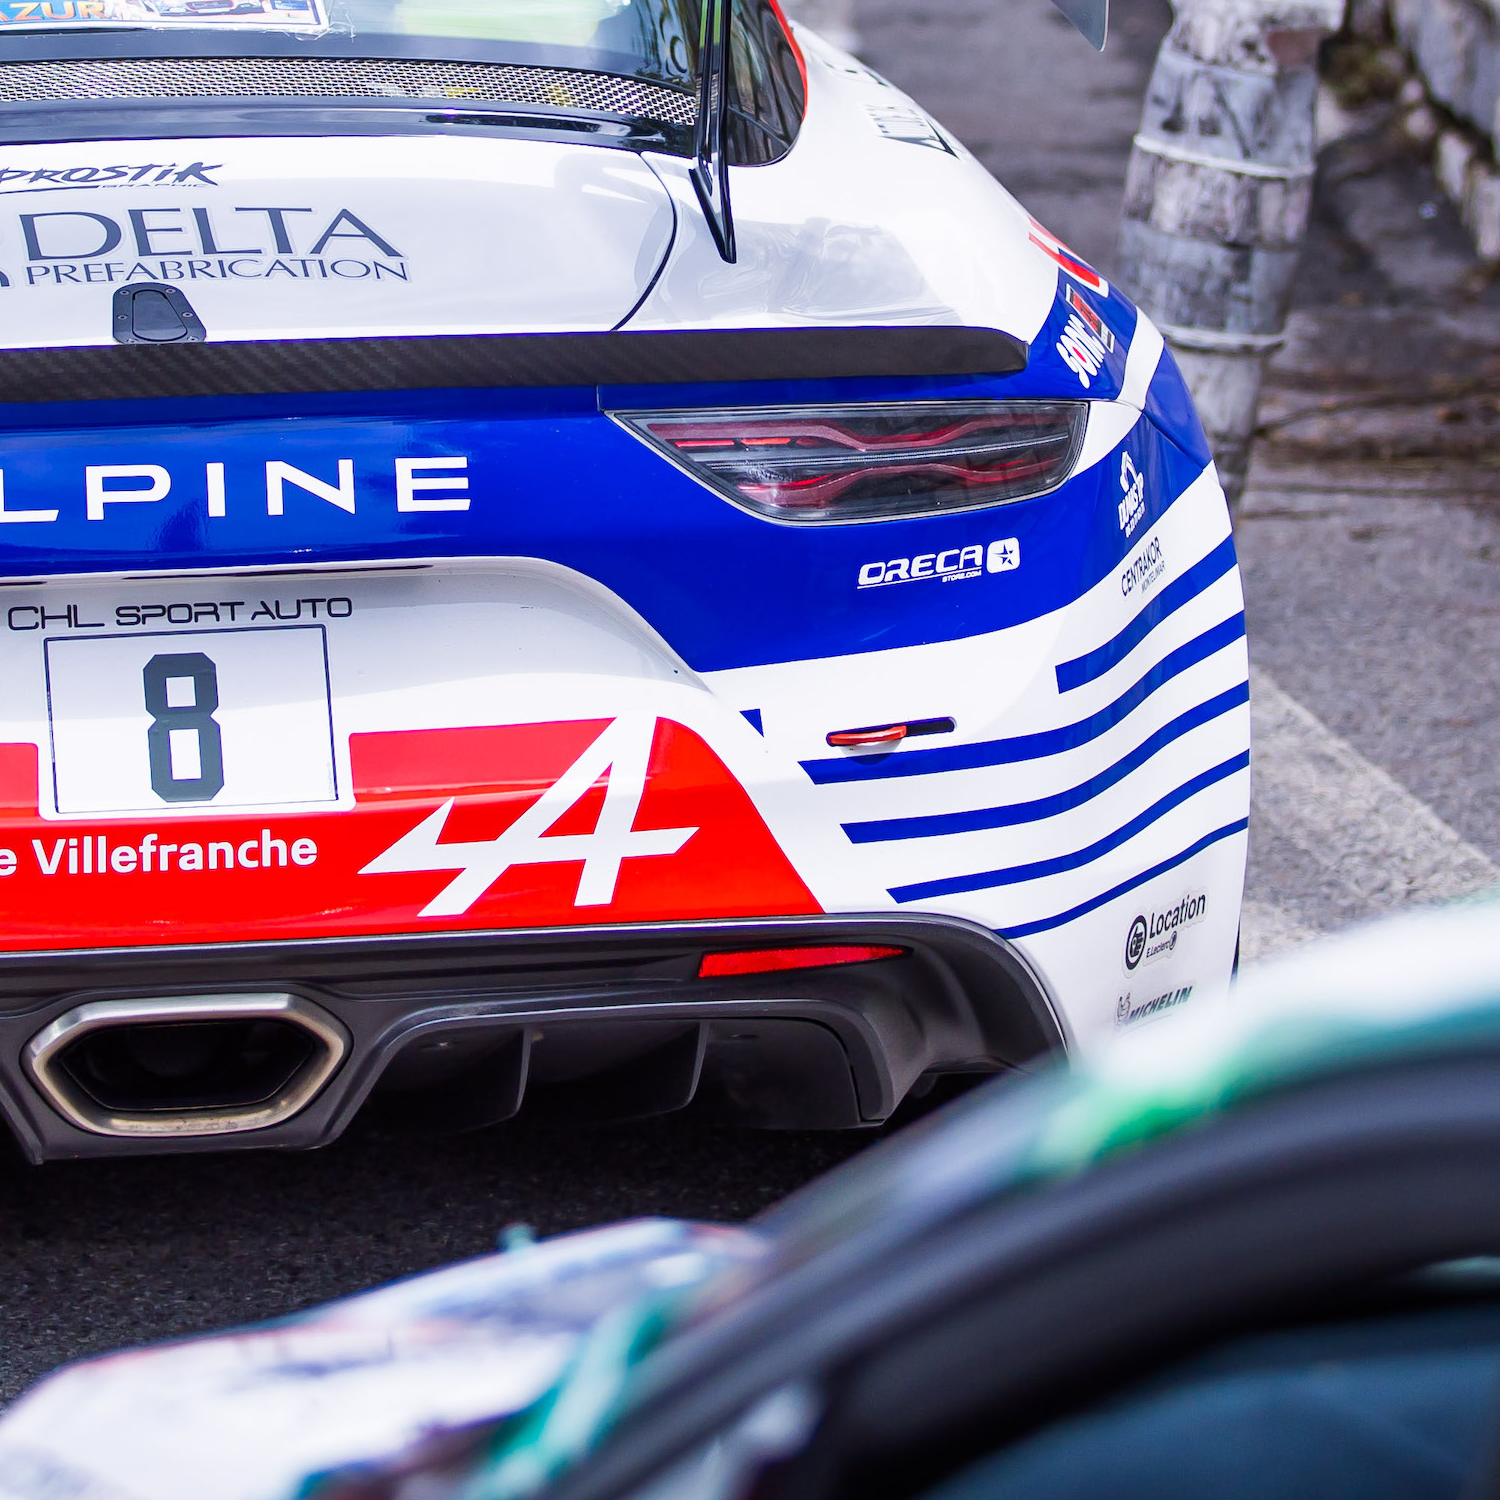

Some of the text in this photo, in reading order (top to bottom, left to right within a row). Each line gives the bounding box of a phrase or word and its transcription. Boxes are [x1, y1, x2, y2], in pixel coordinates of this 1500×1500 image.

[19, 207, 403, 262] DELTA
[26, 258, 411, 287] PREFABRICATION
[857, 545, 984, 586] ORECA
[942, 570, 982, 583] STORE.COM
[1121, 536, 1163, 597] CENTRAKOR
[7, 597, 353, 631] CHL SPORT AUTO
[142, 651, 225, 802] 8
[30, 830, 318, 876] Villefranche
[1149, 894, 1206, 939] Location
[1128, 986, 1193, 1023] MICHELIN
